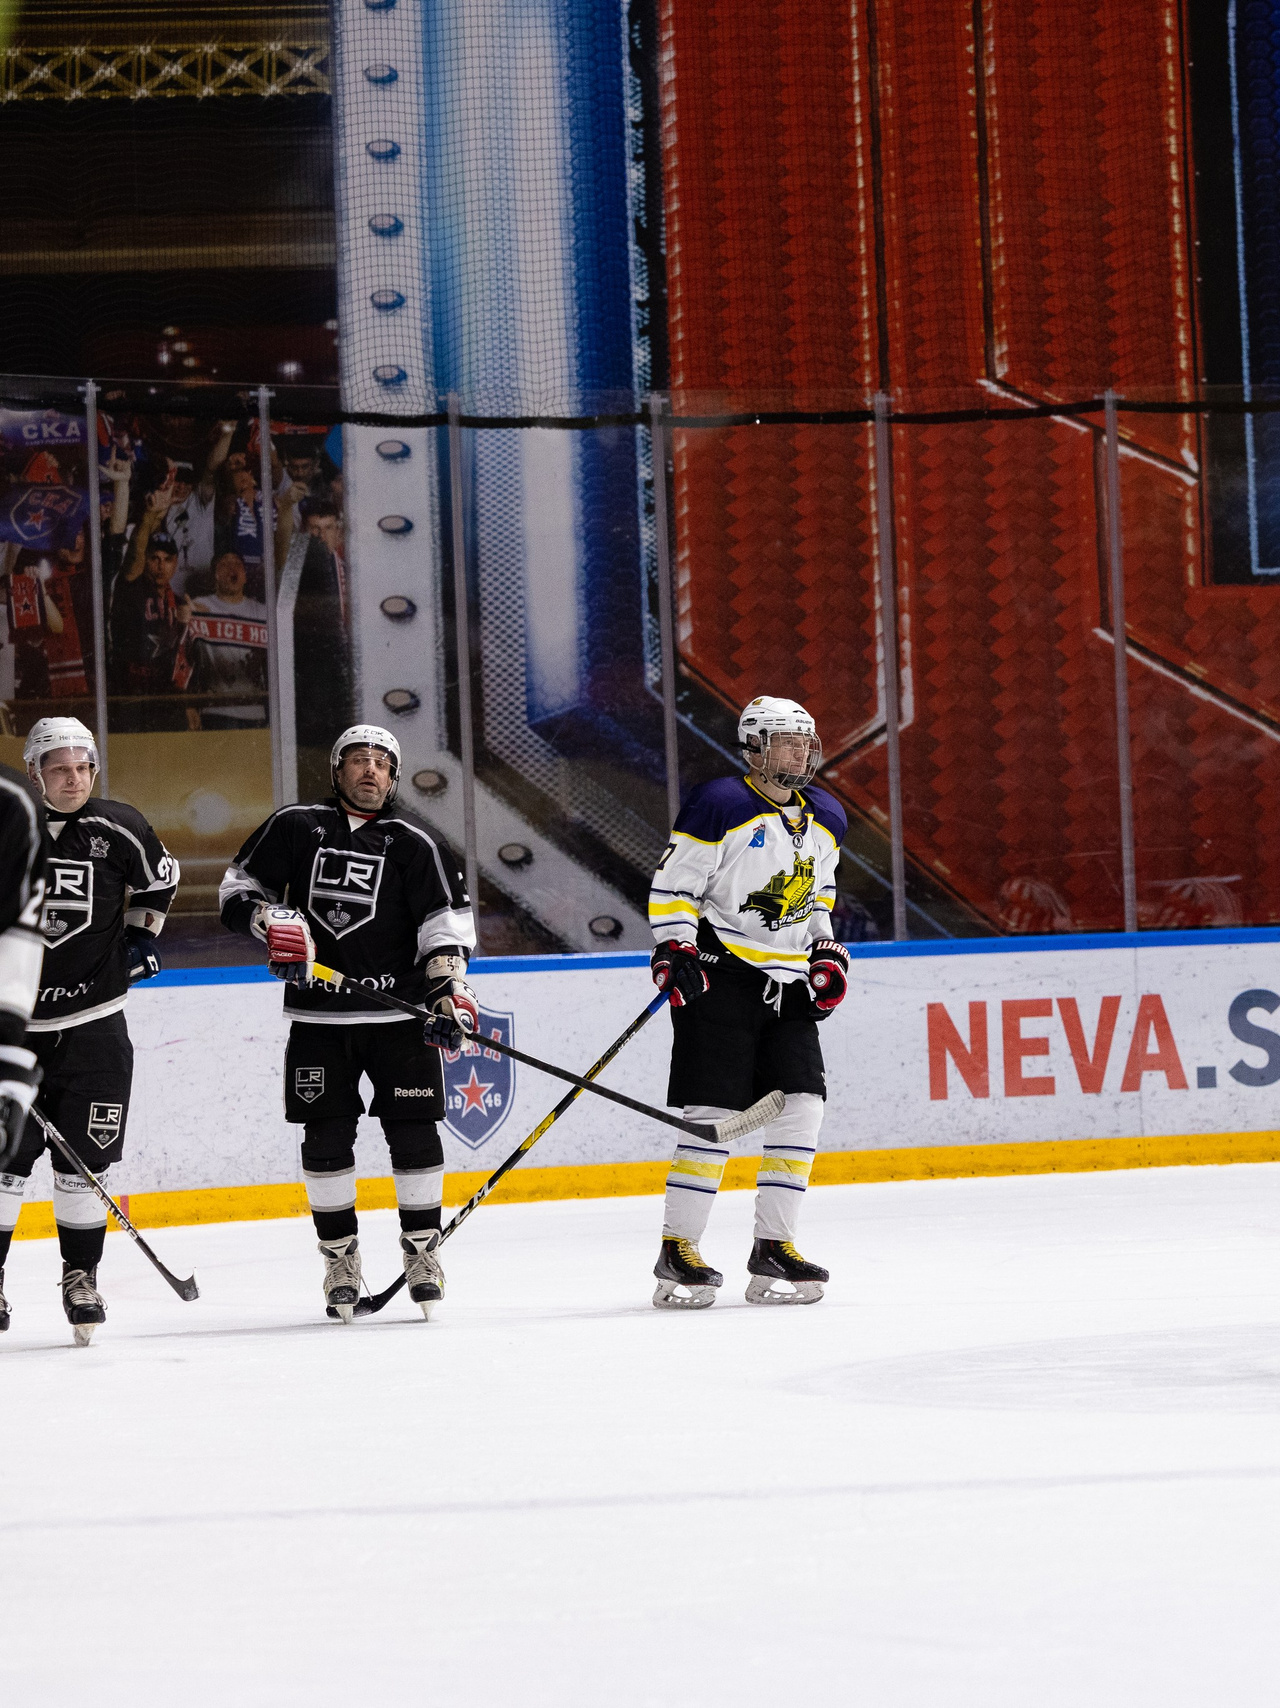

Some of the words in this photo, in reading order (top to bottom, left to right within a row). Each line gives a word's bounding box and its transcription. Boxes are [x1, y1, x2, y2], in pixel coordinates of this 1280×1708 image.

[216, 621, 243, 641] ICE
[46, 868, 86, 896] R
[316, 856, 376, 891] LR
[298, 1071, 322, 1082] LR
[394, 1087, 435, 1097] Reebok
[448, 1095, 462, 1109] 19
[485, 1092, 502, 1107] 46
[92, 1107, 120, 1123] LR
